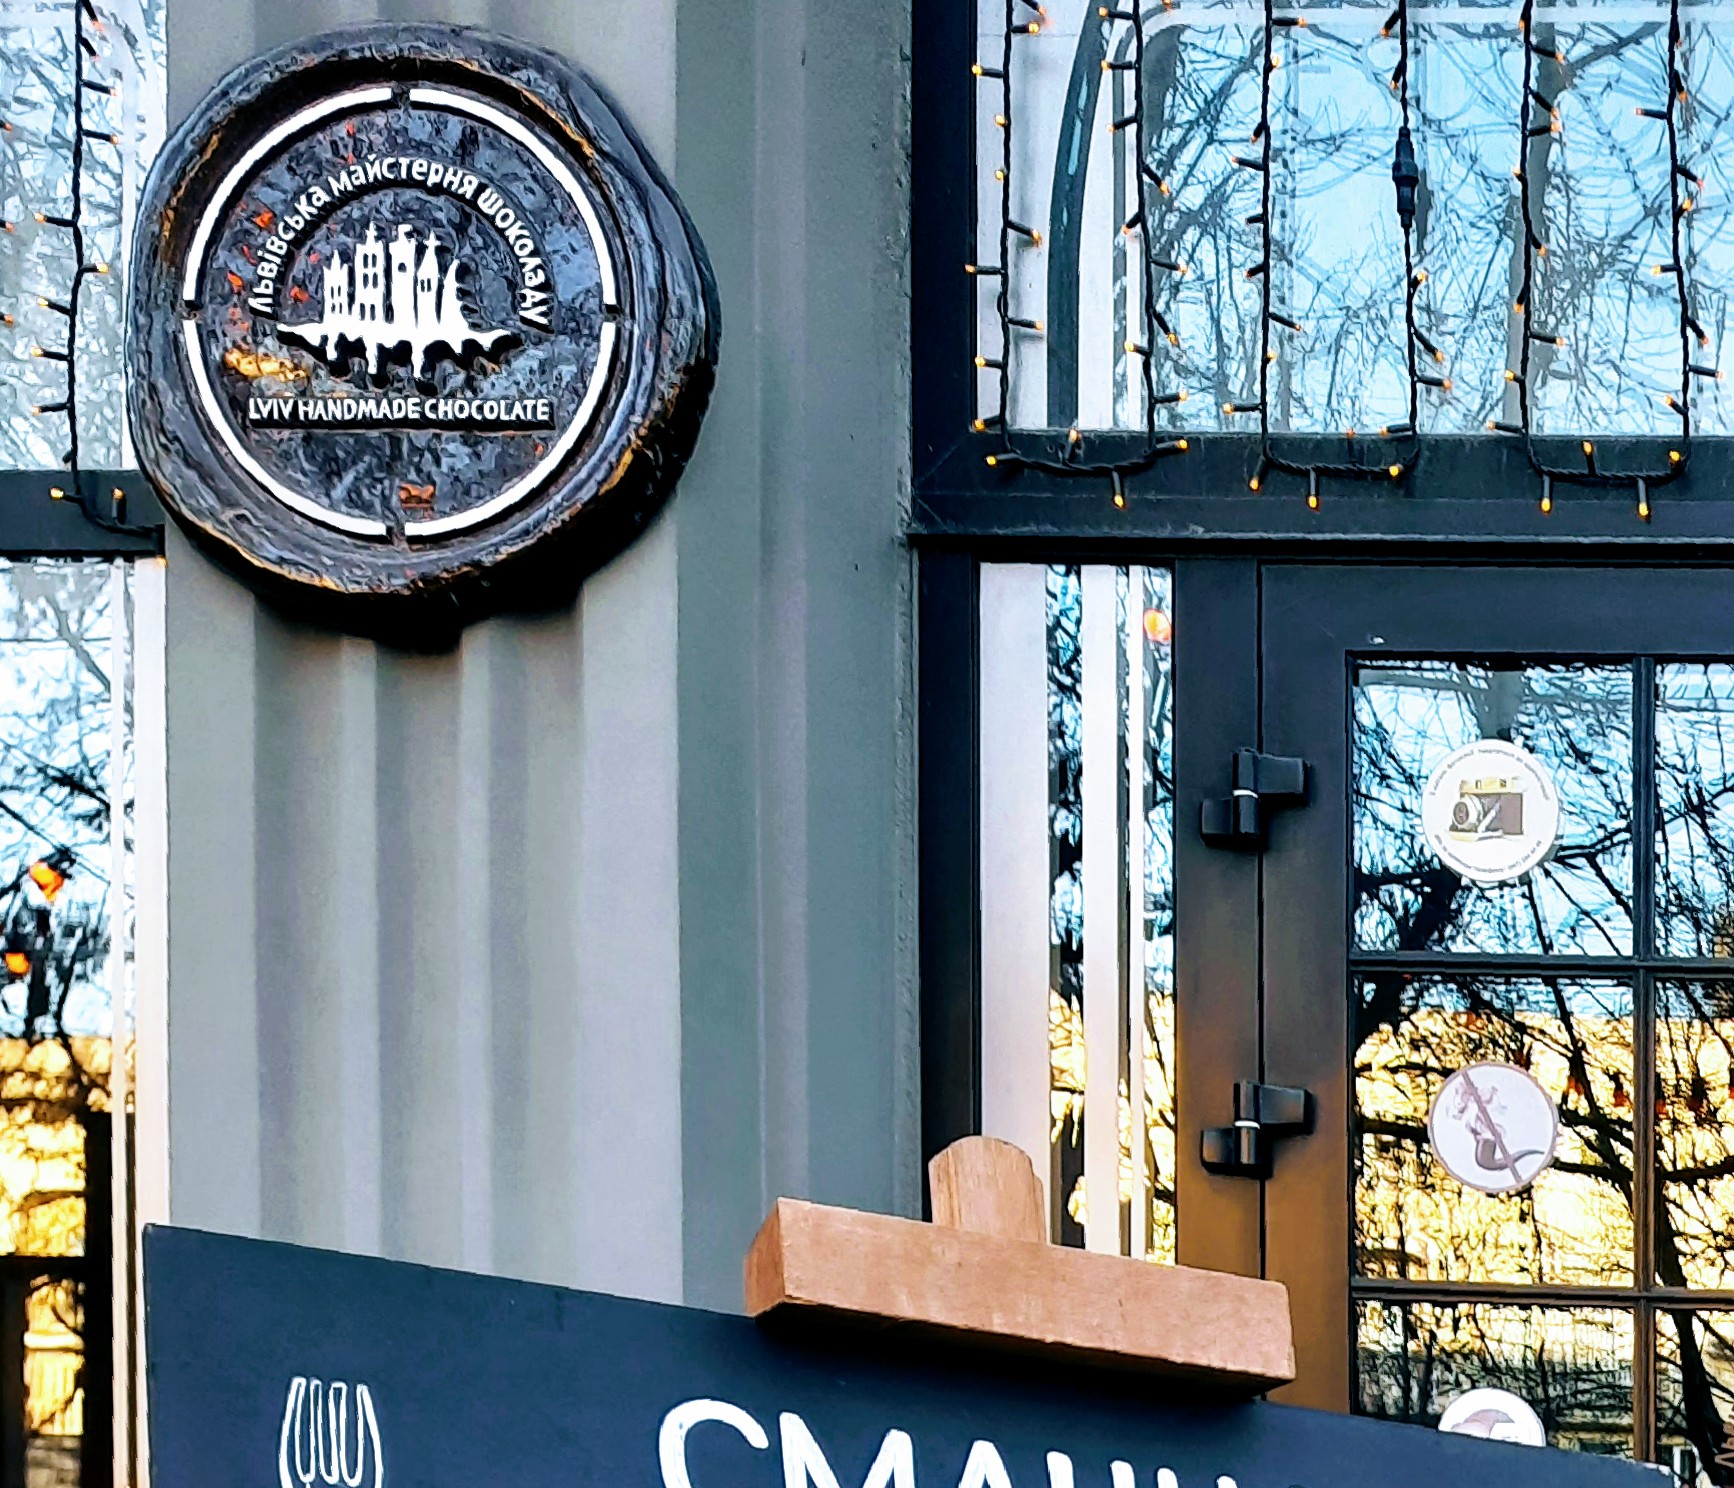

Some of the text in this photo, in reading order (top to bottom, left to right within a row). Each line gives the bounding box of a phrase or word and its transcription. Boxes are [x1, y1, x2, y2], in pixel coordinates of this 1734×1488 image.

[247, 152, 551, 326] Львівська майстерня шоколаду
[248, 397, 551, 421] LVIV HANDMADE CHOCOLATE
